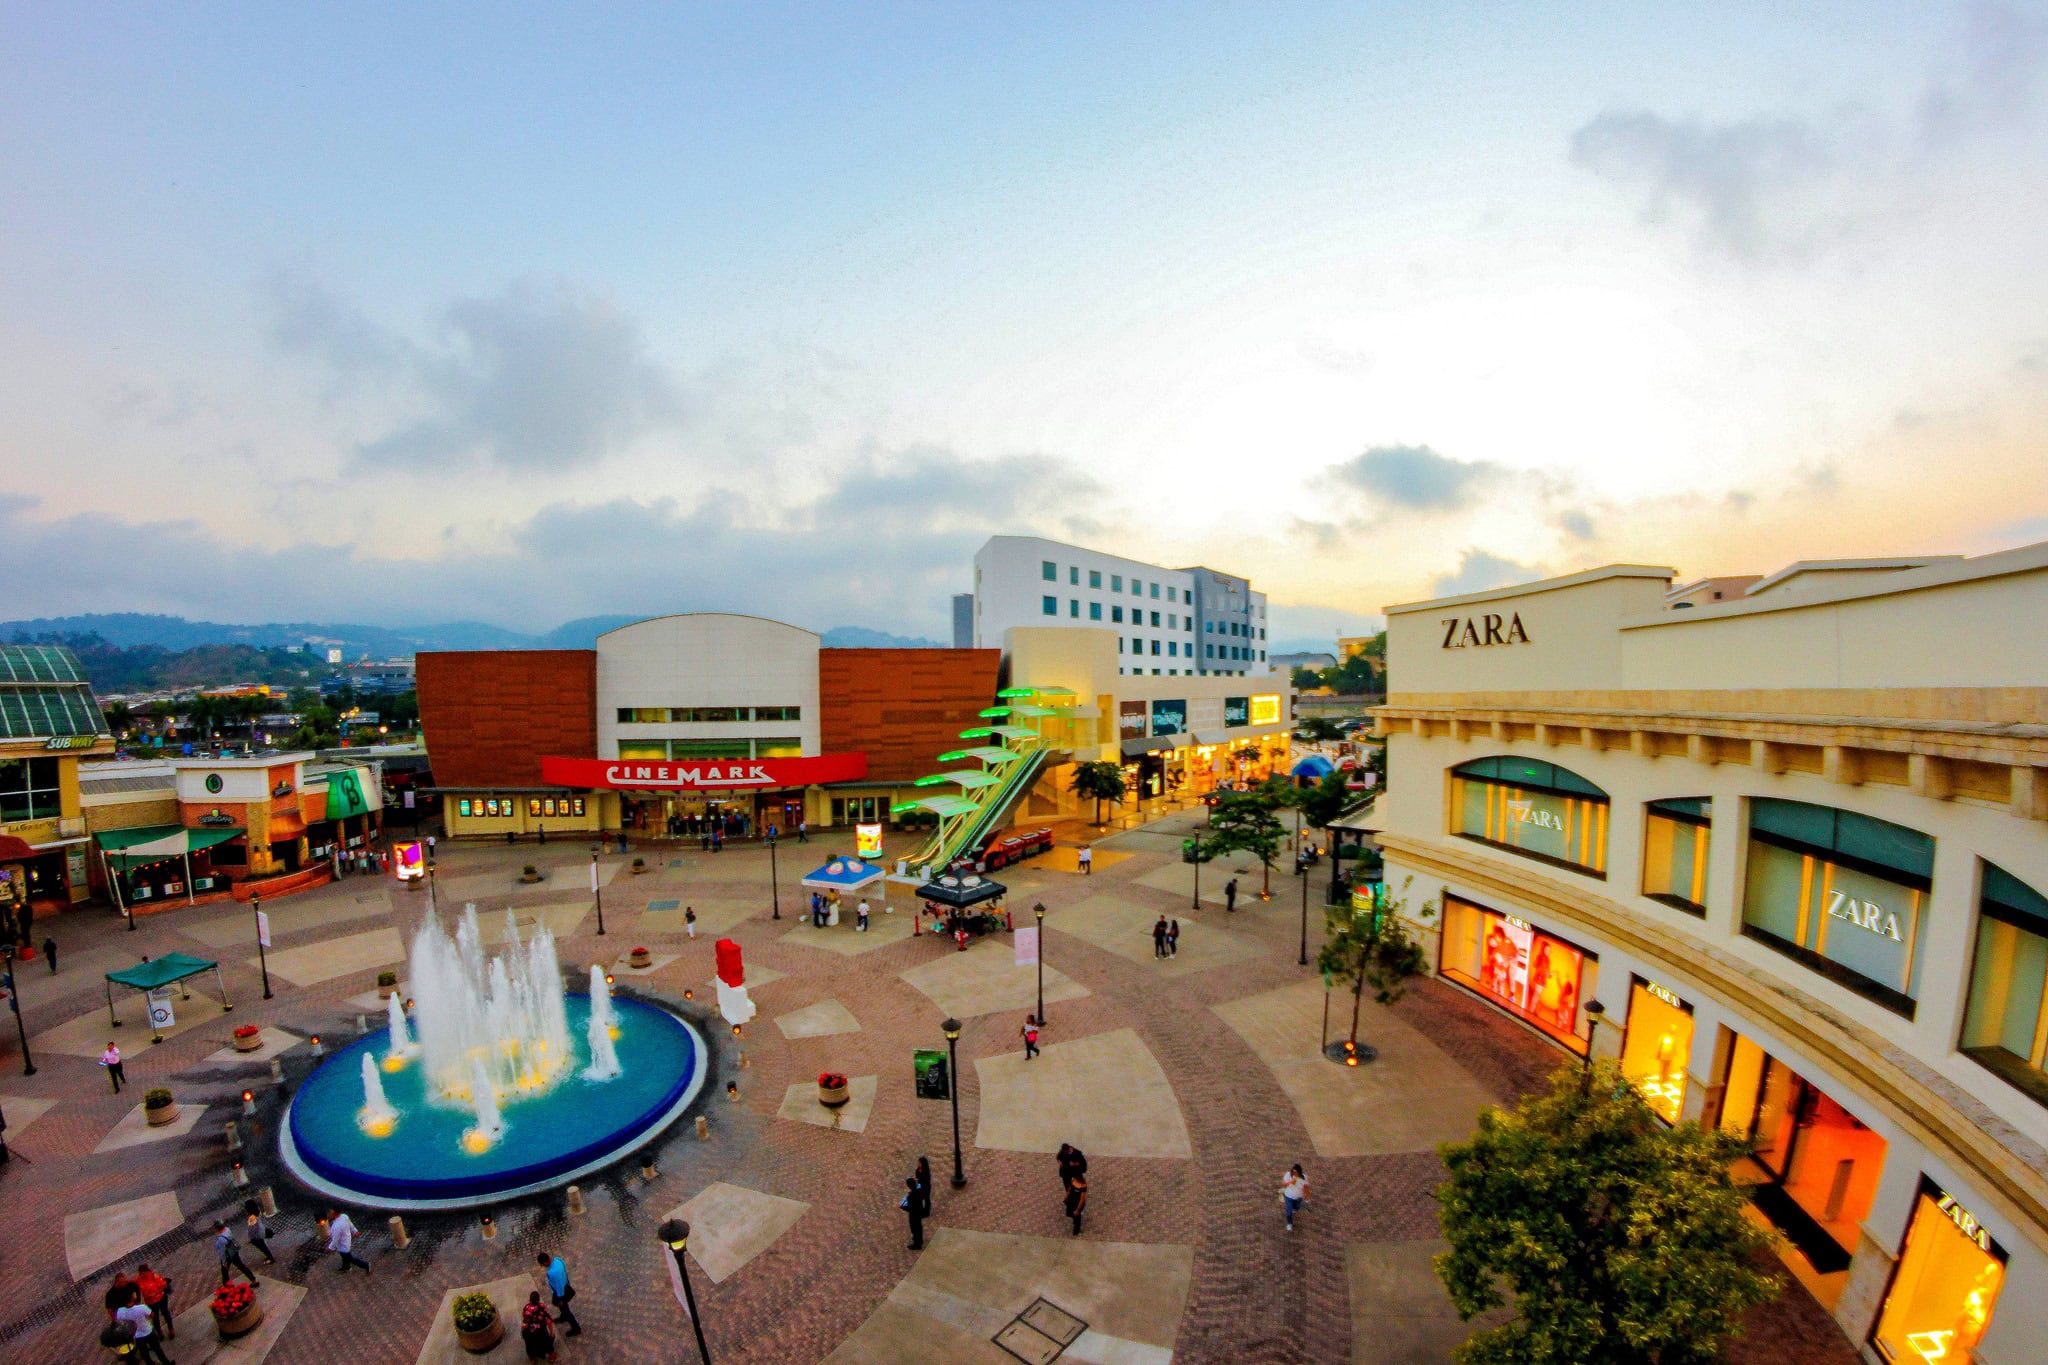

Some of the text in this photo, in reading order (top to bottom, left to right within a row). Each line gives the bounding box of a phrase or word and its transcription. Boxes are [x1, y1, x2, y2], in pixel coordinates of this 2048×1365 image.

[1441, 611, 1531, 648] ZARA
[46, 736, 95, 749] SUBWAY
[606, 766, 777, 785] CINEMARK
[1515, 807, 1563, 831] ZARA
[1504, 911, 1532, 931] ZARA
[1828, 890, 1904, 942] ZARA
[1646, 981, 1680, 1008] ZARA
[1937, 1190, 1990, 1251] ZARA
